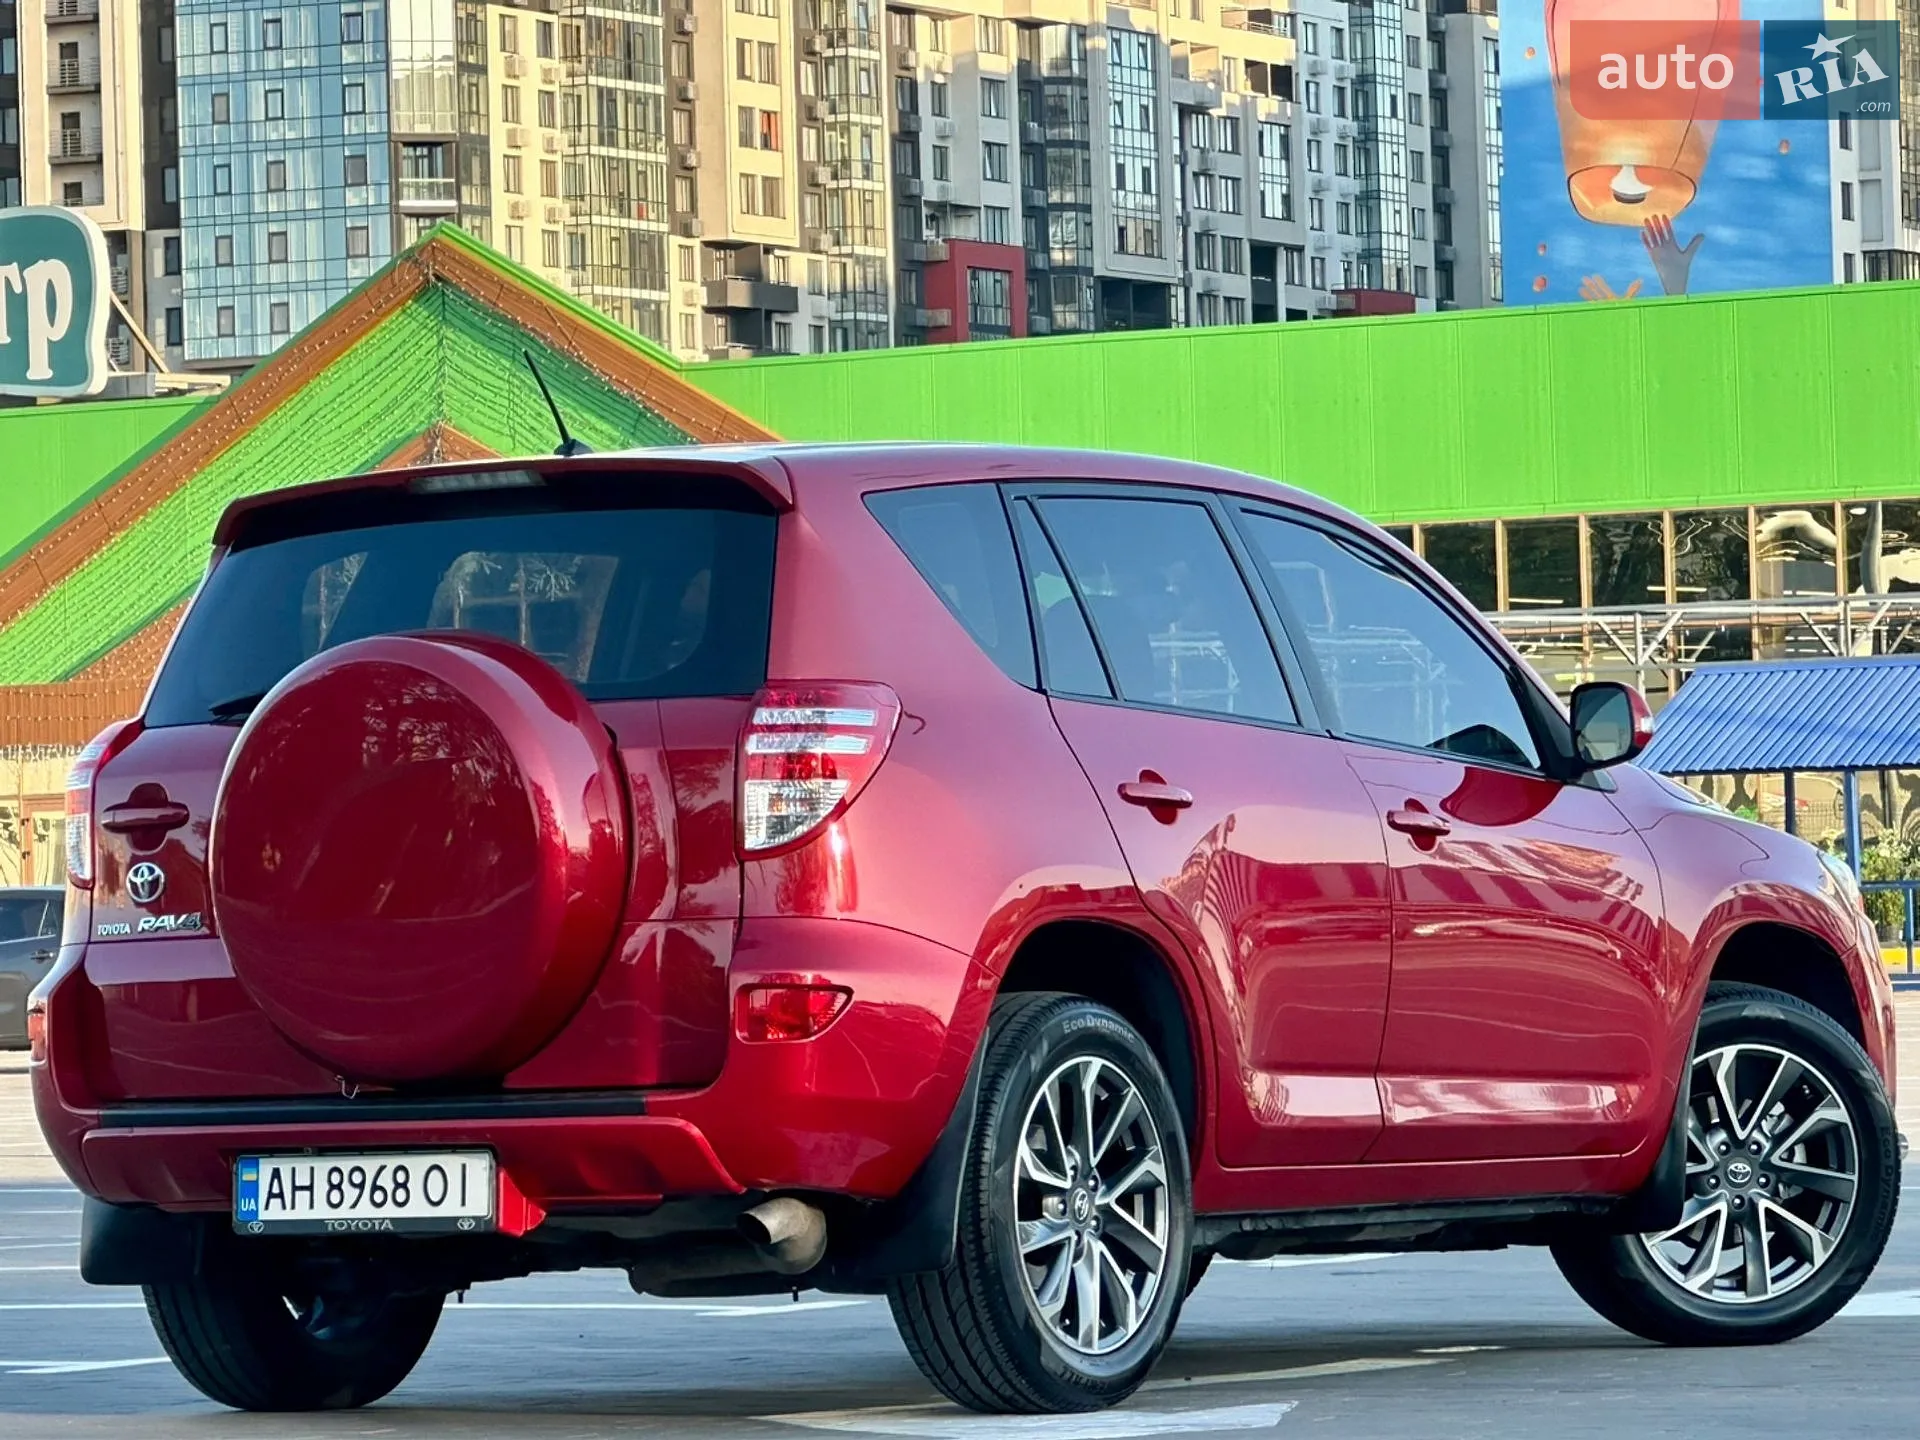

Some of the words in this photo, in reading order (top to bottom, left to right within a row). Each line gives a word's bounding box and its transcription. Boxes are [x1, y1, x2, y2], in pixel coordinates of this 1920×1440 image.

[97, 923, 132, 937] TOYOTA
[137, 911, 202, 933] RAV4
[263, 1165, 315, 1211] AH
[325, 1164, 411, 1210] 8968
[423, 1162, 467, 1208] OI
[241, 1197, 257, 1212] UA
[324, 1218, 394, 1232] TOYOTA
